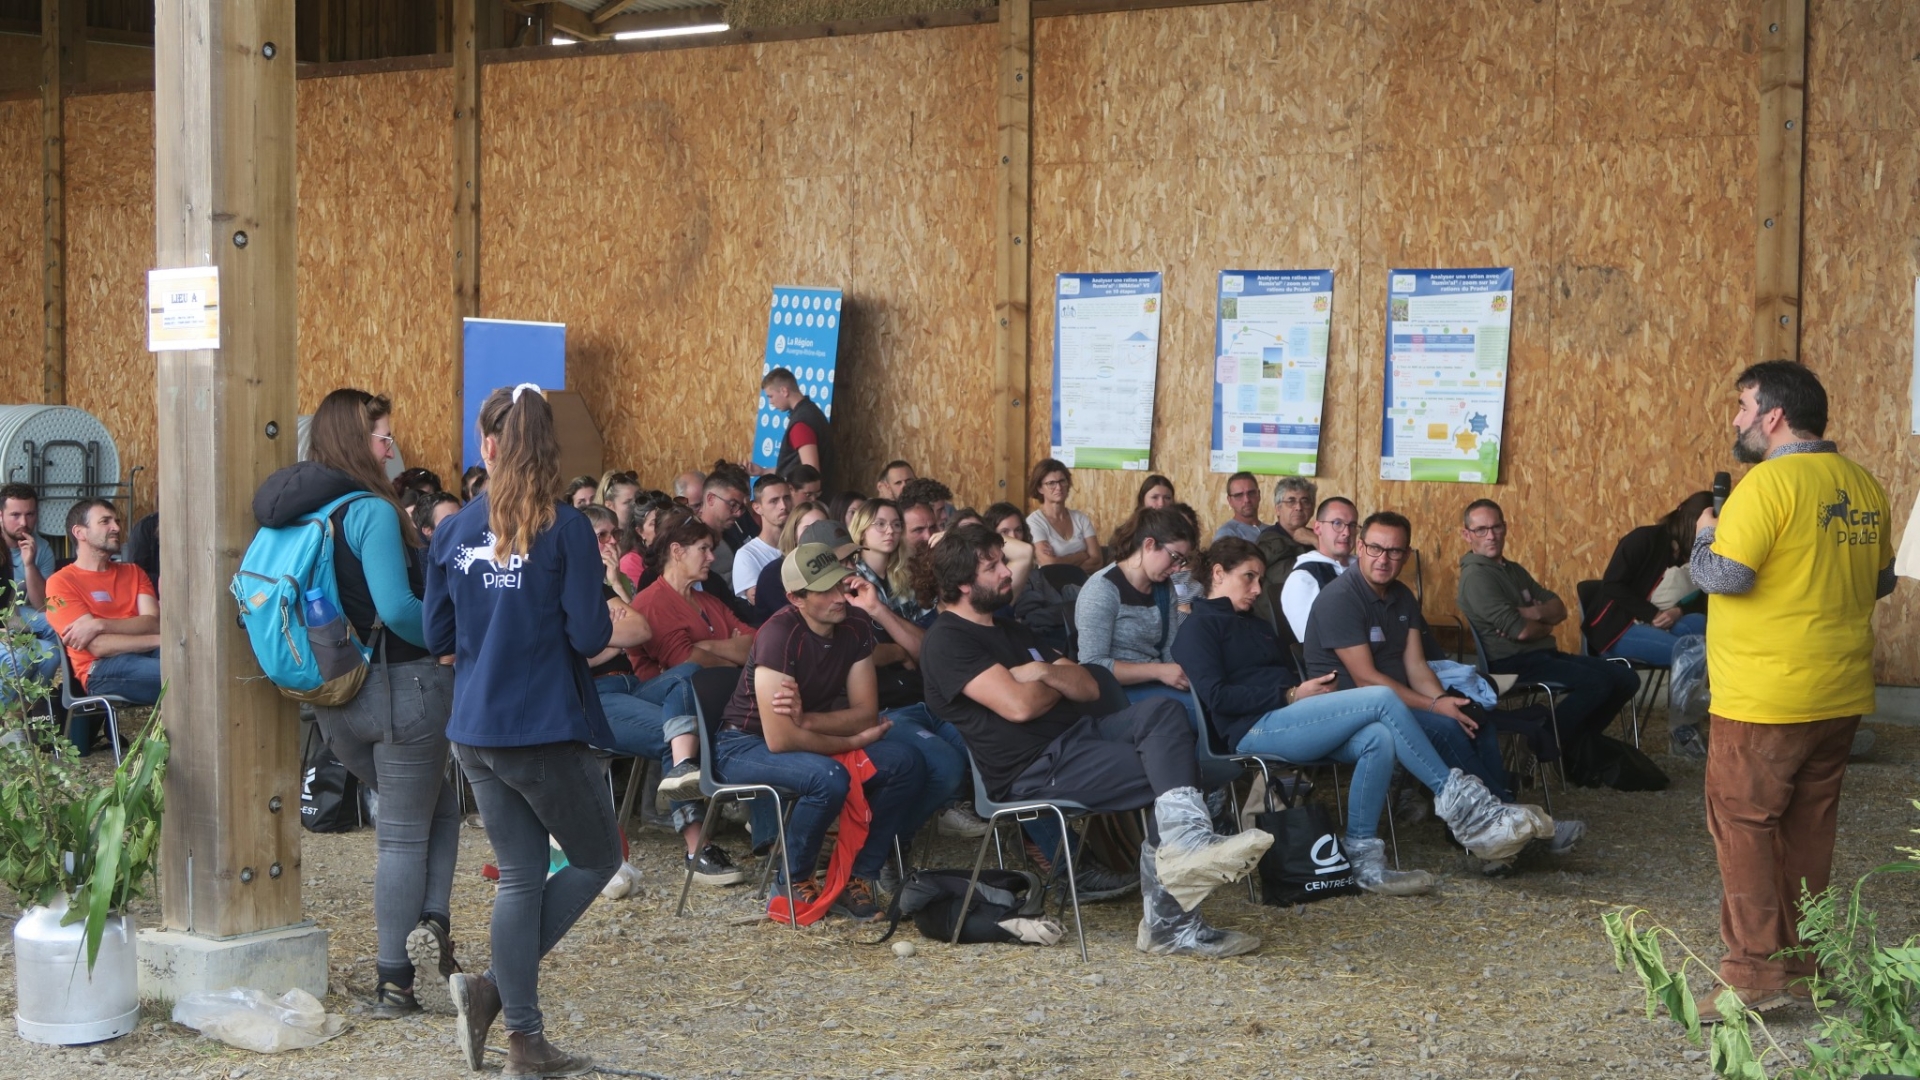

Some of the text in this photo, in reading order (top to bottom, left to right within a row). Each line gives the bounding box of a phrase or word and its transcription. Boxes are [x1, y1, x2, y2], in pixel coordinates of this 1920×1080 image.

[171, 292, 198, 304] LIEU A
[787, 337, 814, 349] La Région
